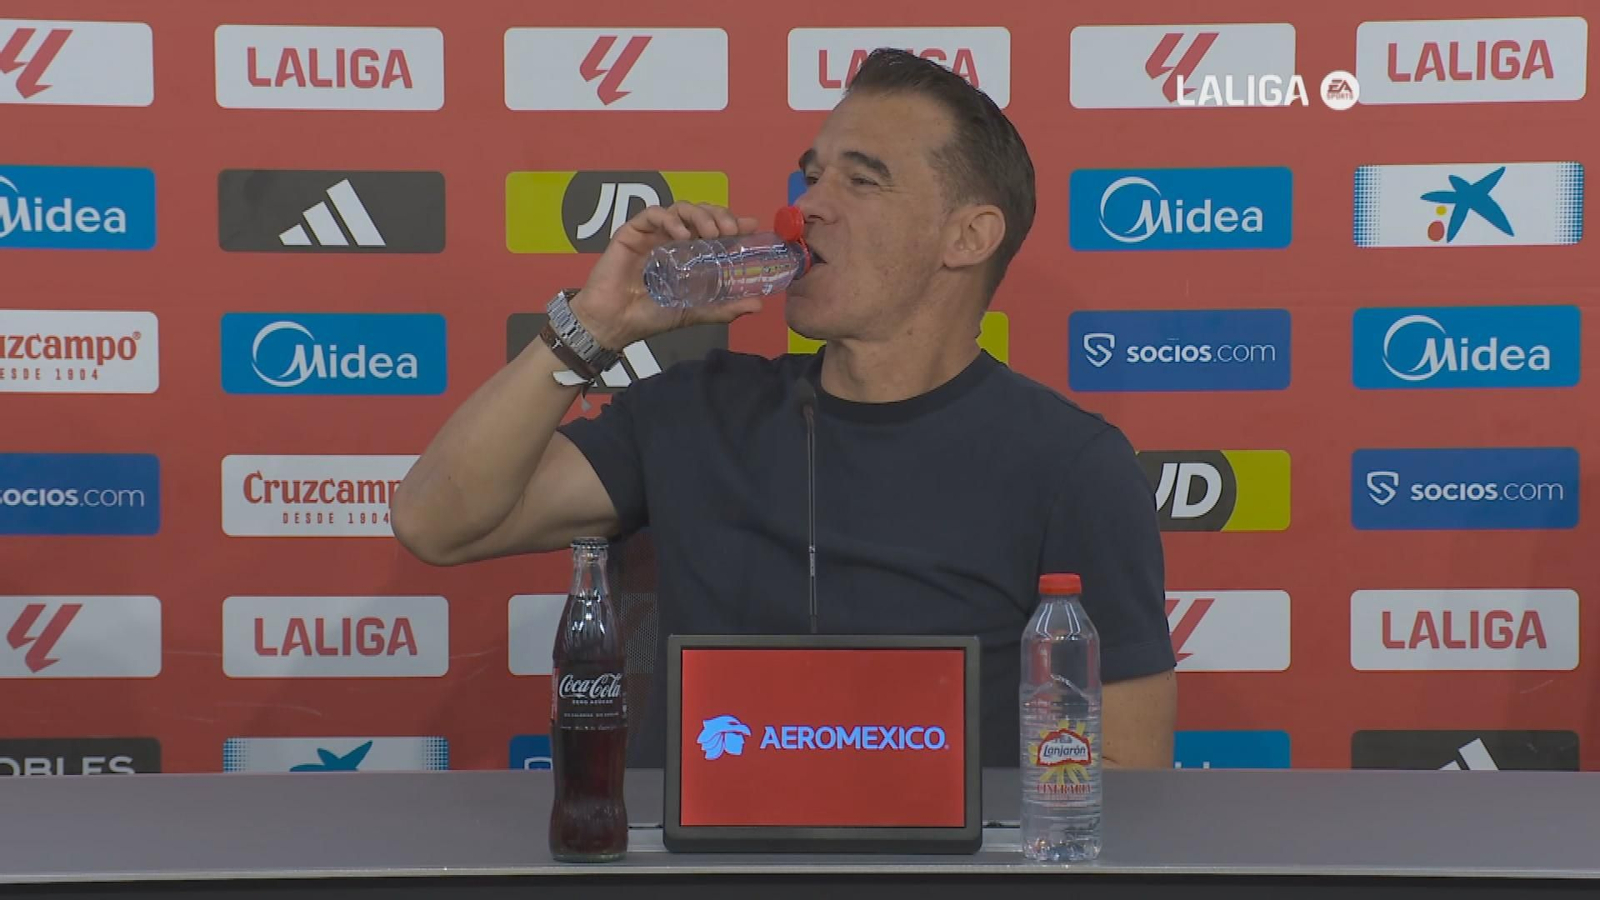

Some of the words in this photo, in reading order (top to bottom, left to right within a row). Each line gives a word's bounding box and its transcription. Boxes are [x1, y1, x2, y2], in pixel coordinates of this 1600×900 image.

[247, 46, 413, 89] LALIGA
[818, 47, 980, 89] LAA
[1387, 39, 1555, 83] LALIGA
[1124, 199, 1264, 235] Midea
[278, 343, 418, 379] Midea
[1412, 337, 1552, 374] Midea
[55, 367, 98, 381] 1904
[0, 488, 146, 507] ocios.com
[282, 512, 335, 525] DESDE
[347, 512, 390, 525] 1904
[254, 617, 418, 657] LALIGA
[1381, 609, 1547, 649] LALIGA
[559, 673, 622, 698] Coca-Cola
[760, 725, 946, 750] AEROMEXICO
[1043, 744, 1086, 758] Lanjarón
